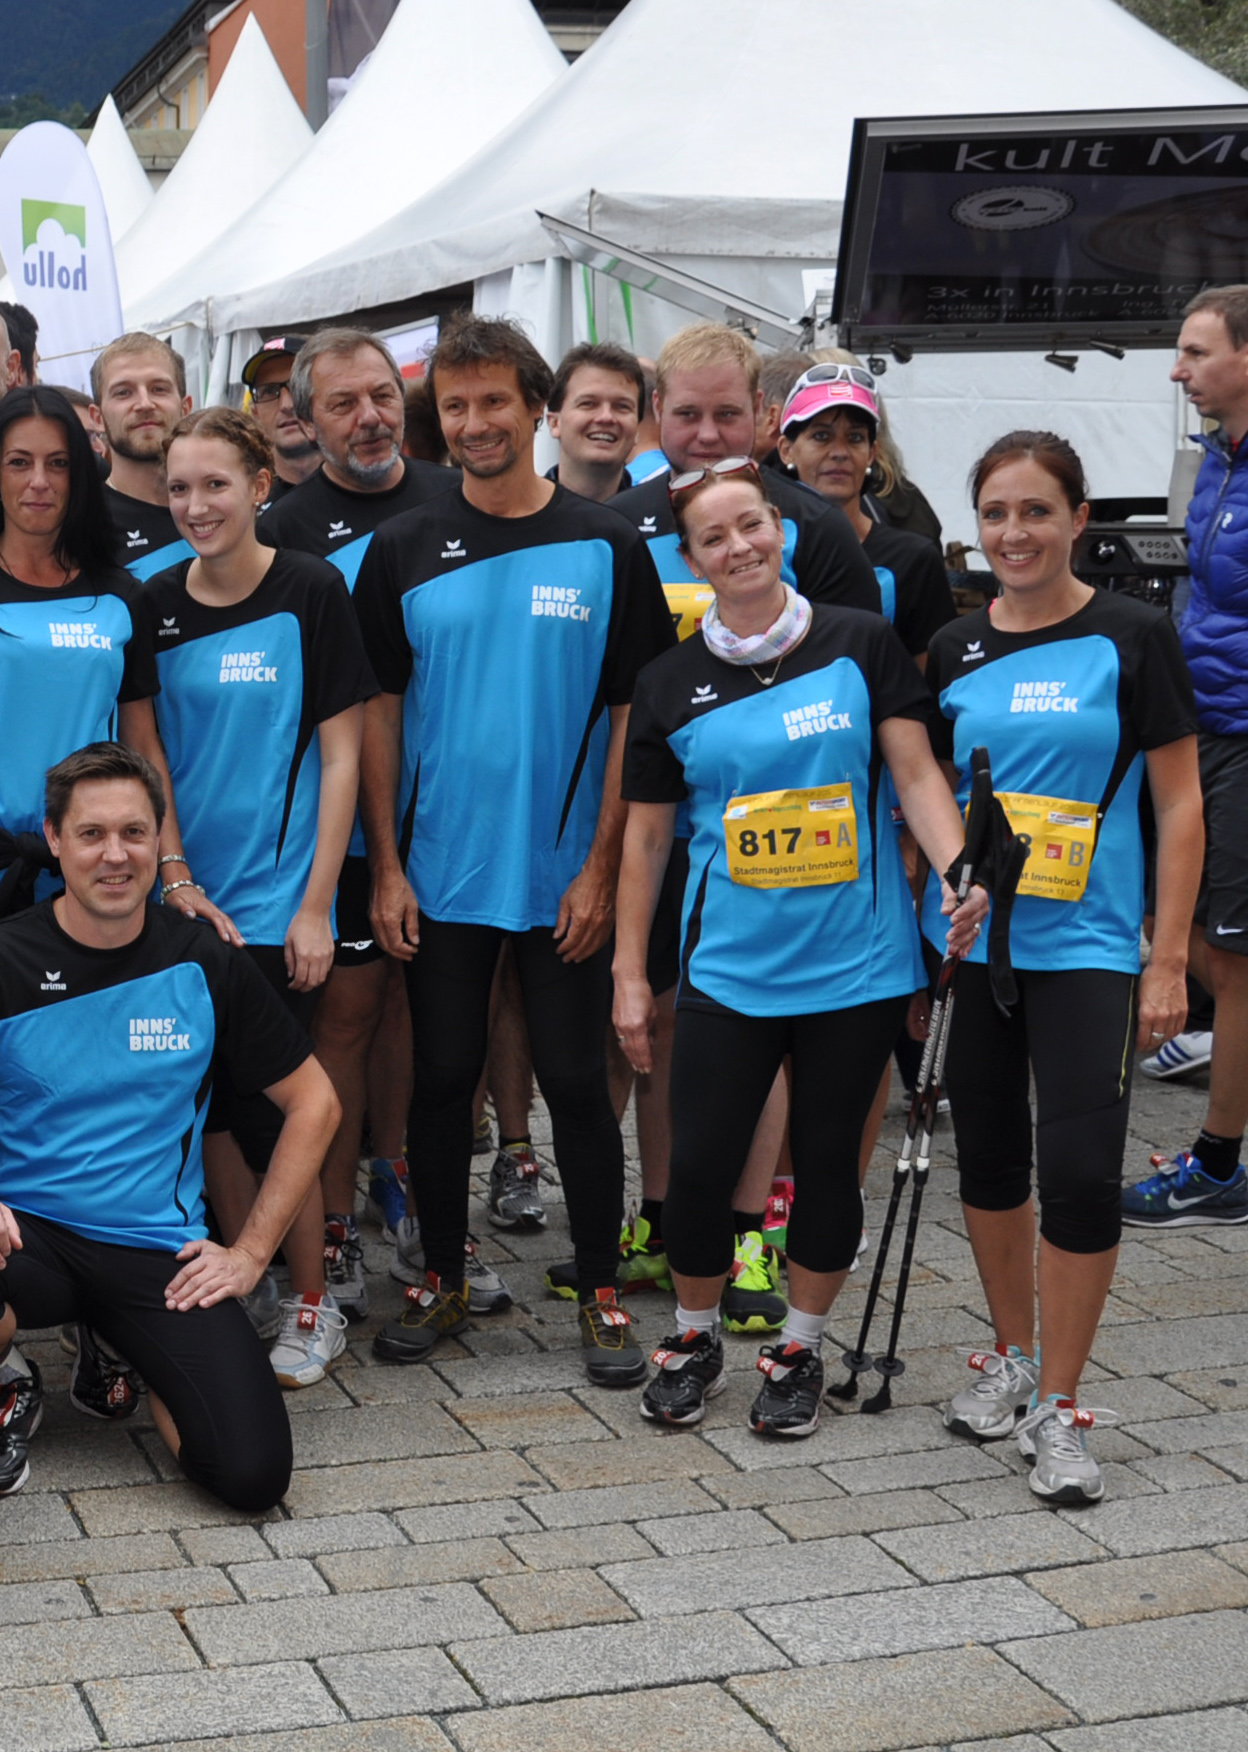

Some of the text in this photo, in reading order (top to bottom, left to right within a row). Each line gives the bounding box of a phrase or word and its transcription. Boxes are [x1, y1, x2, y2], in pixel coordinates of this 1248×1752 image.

[954, 139, 1113, 171] kult
[927, 285, 970, 299] 3x
[983, 284, 1014, 298] in
[327, 527, 353, 539] erima
[126, 537, 149, 548] erima
[440, 549, 467, 559] erima
[532, 584, 581, 603] INNS'
[531, 600, 592, 623] BRUCK
[49, 622, 97, 635] INNS'
[158, 626, 180, 637] erima
[50, 633, 113, 651] BRUCK
[221, 651, 266, 668] INNS'
[219, 666, 278, 684] BRUCK
[691, 692, 718, 704] erima
[1013, 681, 1067, 698] INNS'
[1009, 696, 1079, 713] BRUCK
[782, 700, 833, 727] INNS'
[785, 712, 853, 742] BRUCK
[739, 822, 852, 857] 817 A
[1068, 841, 1085, 867] B
[733, 858, 854, 876] Stadtmagistrat Innsbruck
[1030, 872, 1082, 887] Innsbruck
[40, 982, 67, 991] erima
[128, 1017, 177, 1035] INNS'
[128, 1034, 191, 1052] BRUCK
